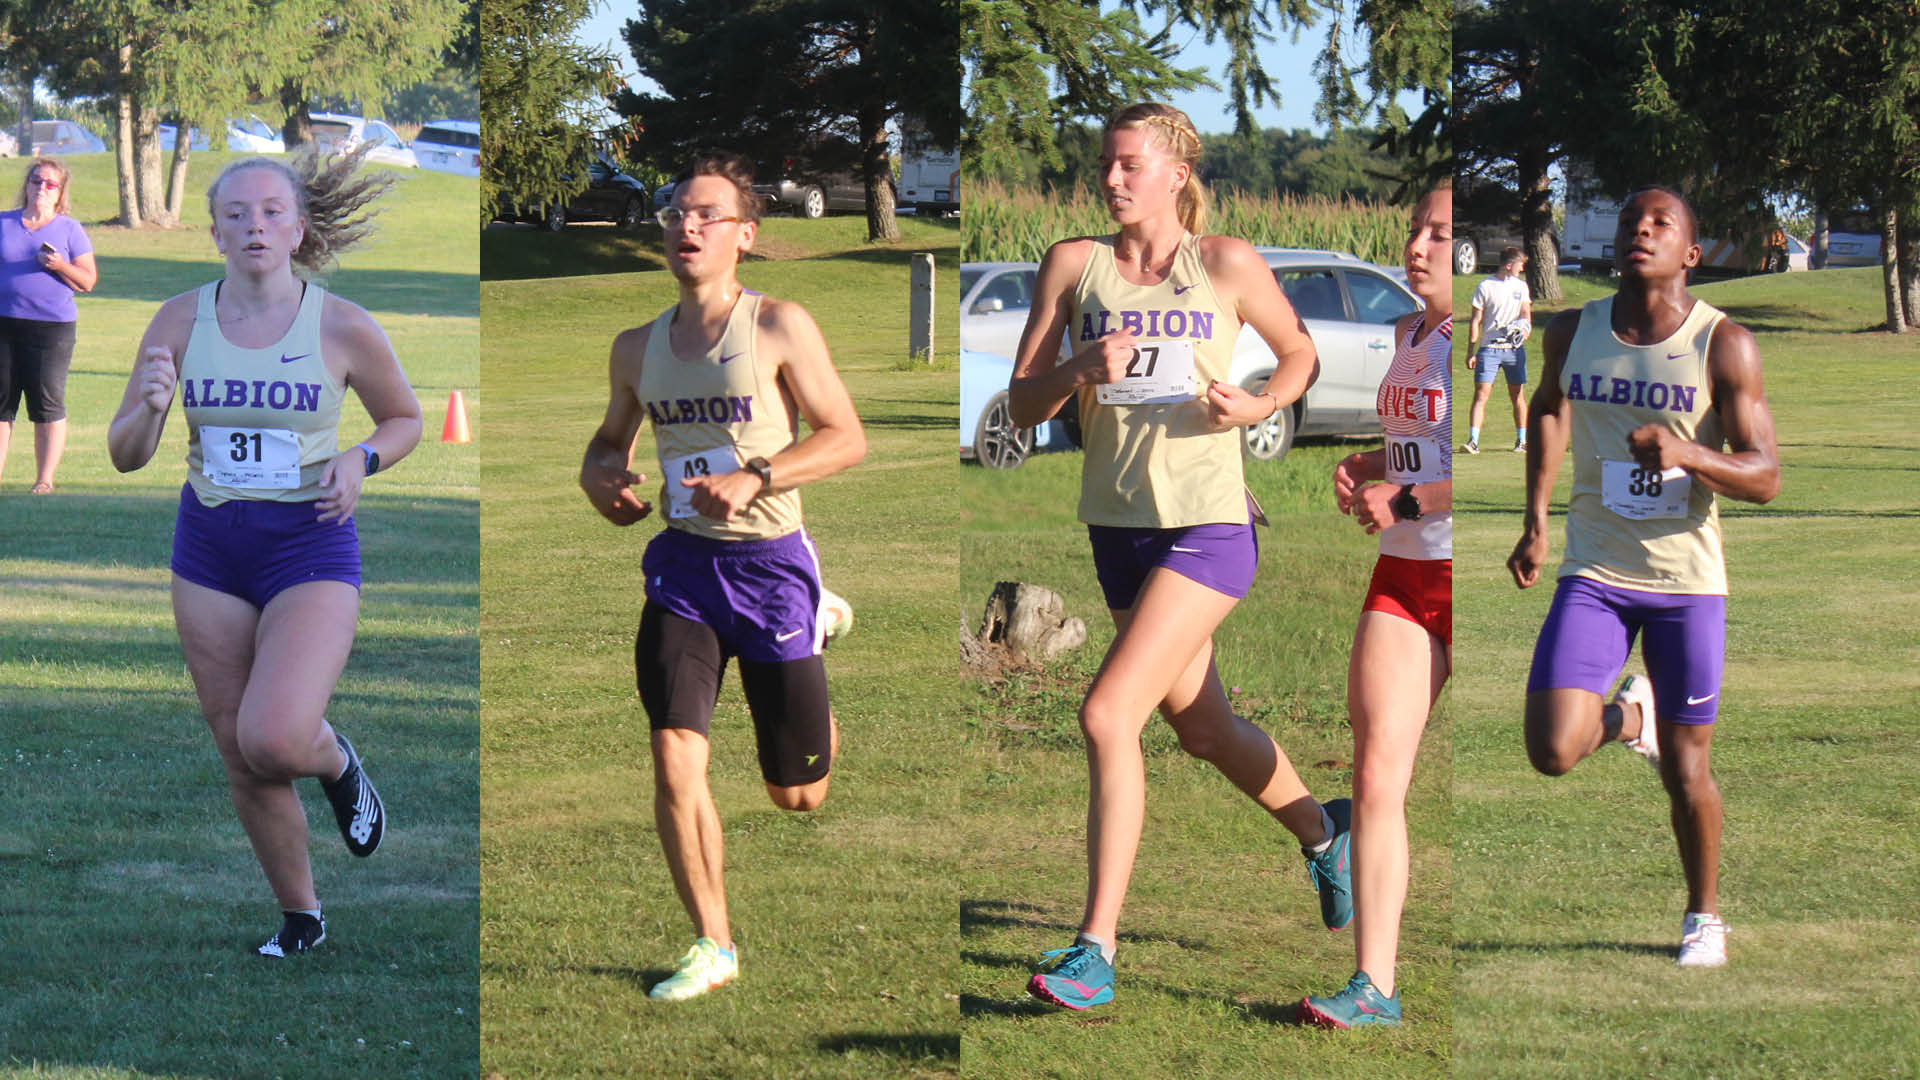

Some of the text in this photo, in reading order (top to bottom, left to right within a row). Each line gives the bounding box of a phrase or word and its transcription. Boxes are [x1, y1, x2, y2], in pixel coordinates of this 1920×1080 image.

[1080, 309, 1214, 341] ALBION
[1125, 347, 1160, 378] 27
[183, 378, 322, 412] ALBION
[1567, 373, 1697, 413] ALBION
[647, 395, 753, 425] ALBION
[230, 432, 262, 462] 31
[1628, 468, 1663, 498] 38
